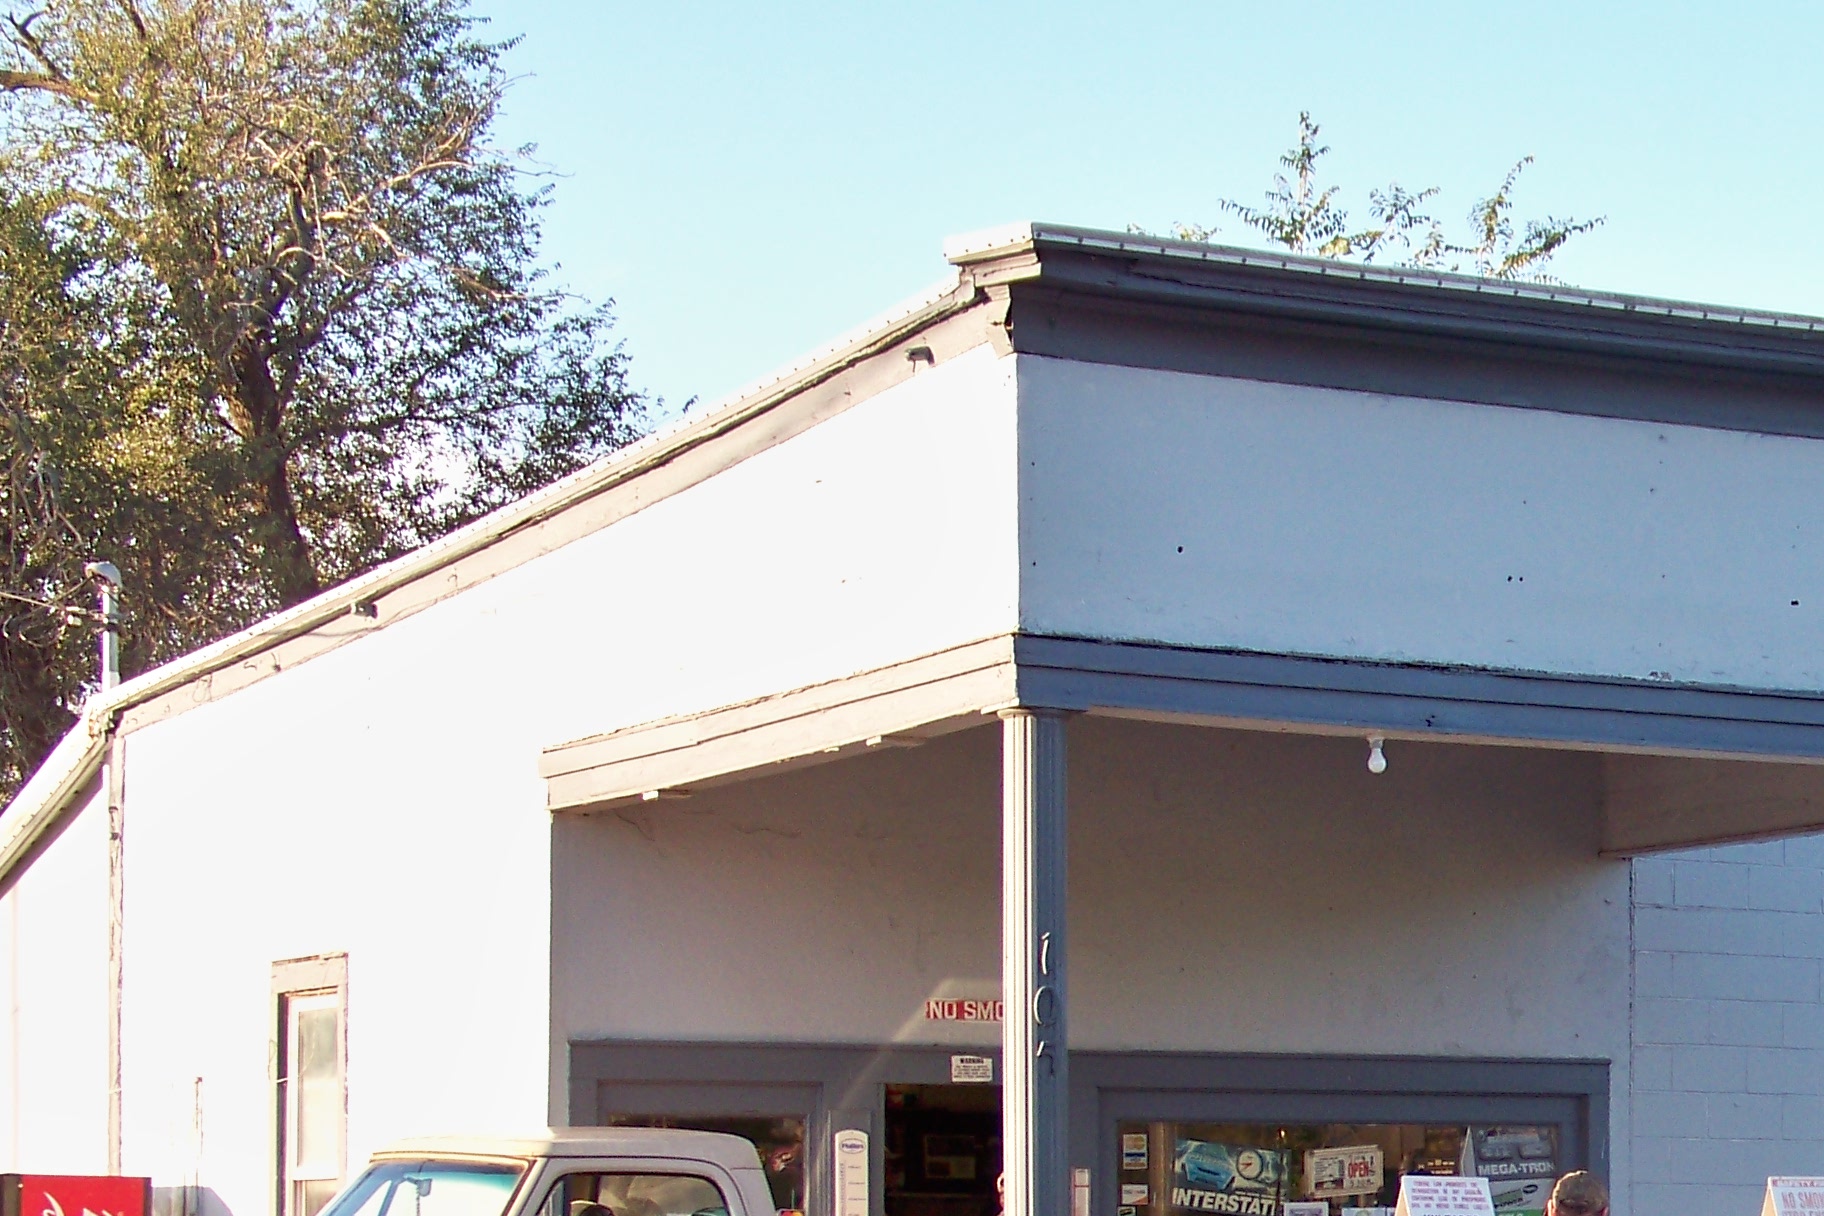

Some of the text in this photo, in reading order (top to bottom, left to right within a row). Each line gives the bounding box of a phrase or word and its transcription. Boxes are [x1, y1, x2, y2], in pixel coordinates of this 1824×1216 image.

[929, 1000, 957, 1020] NO
[1347, 1161, 1370, 1178] OPEN
[1478, 1161, 1555, 1176] MEGA-TRON
[1781, 1191, 1796, 1209] NO
